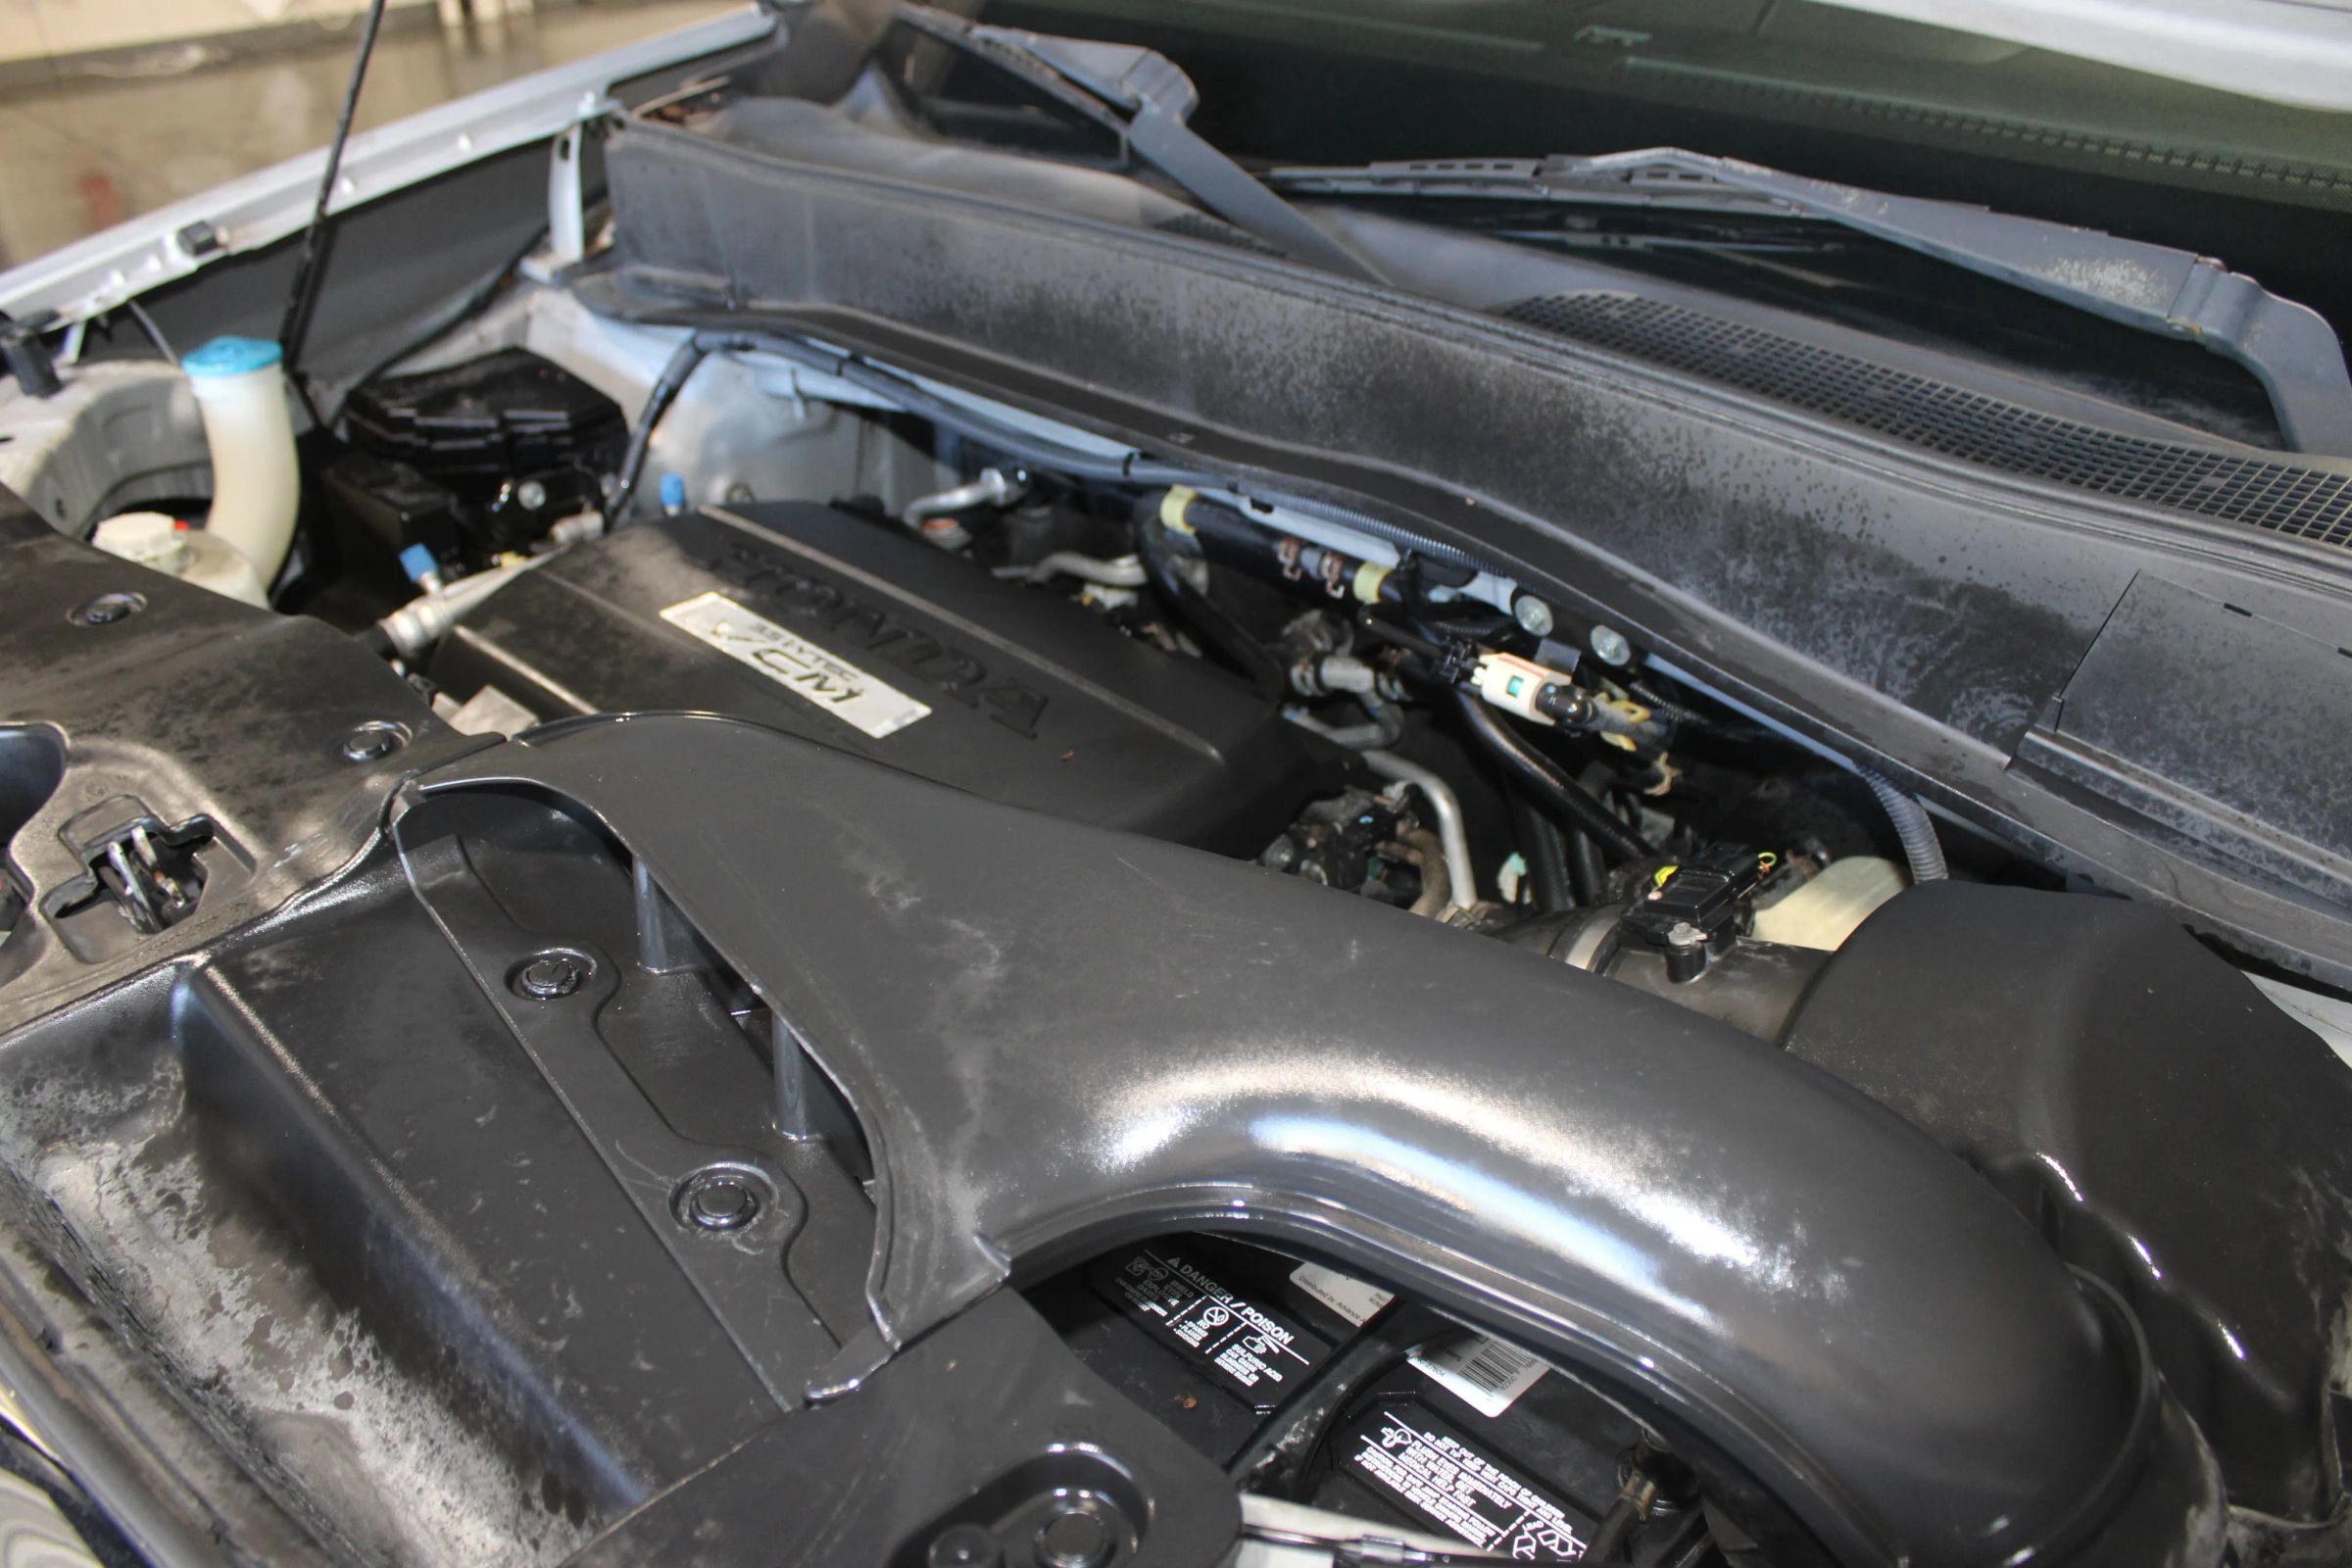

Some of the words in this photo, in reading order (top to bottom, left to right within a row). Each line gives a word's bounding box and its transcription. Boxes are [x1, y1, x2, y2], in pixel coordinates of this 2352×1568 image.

[710, 622, 862, 707] VCM
[1180, 1264, 1235, 1302] DANGER
[1242, 1306, 1295, 1344] POISON
[1198, 1319, 1210, 1329] NO
[1231, 1344, 1268, 1370] SULFURIC
[1264, 1366, 1283, 1381] ACID
[1435, 1439, 1450, 1451] NOT
[1460, 1447, 1475, 1459] OUT
[1398, 1452, 1434, 1477] MEDICAL
[1432, 1475, 1455, 1493] HELP
[1453, 1490, 1477, 1507] FAST
[1405, 1446, 1428, 1463] WITH
[1455, 1480, 1474, 1494] GET
[1411, 1440, 1440, 1460] FLUSH
[1438, 1457, 1460, 1474] EYES
[1458, 1471, 1513, 1509] IMMEDIATELY
